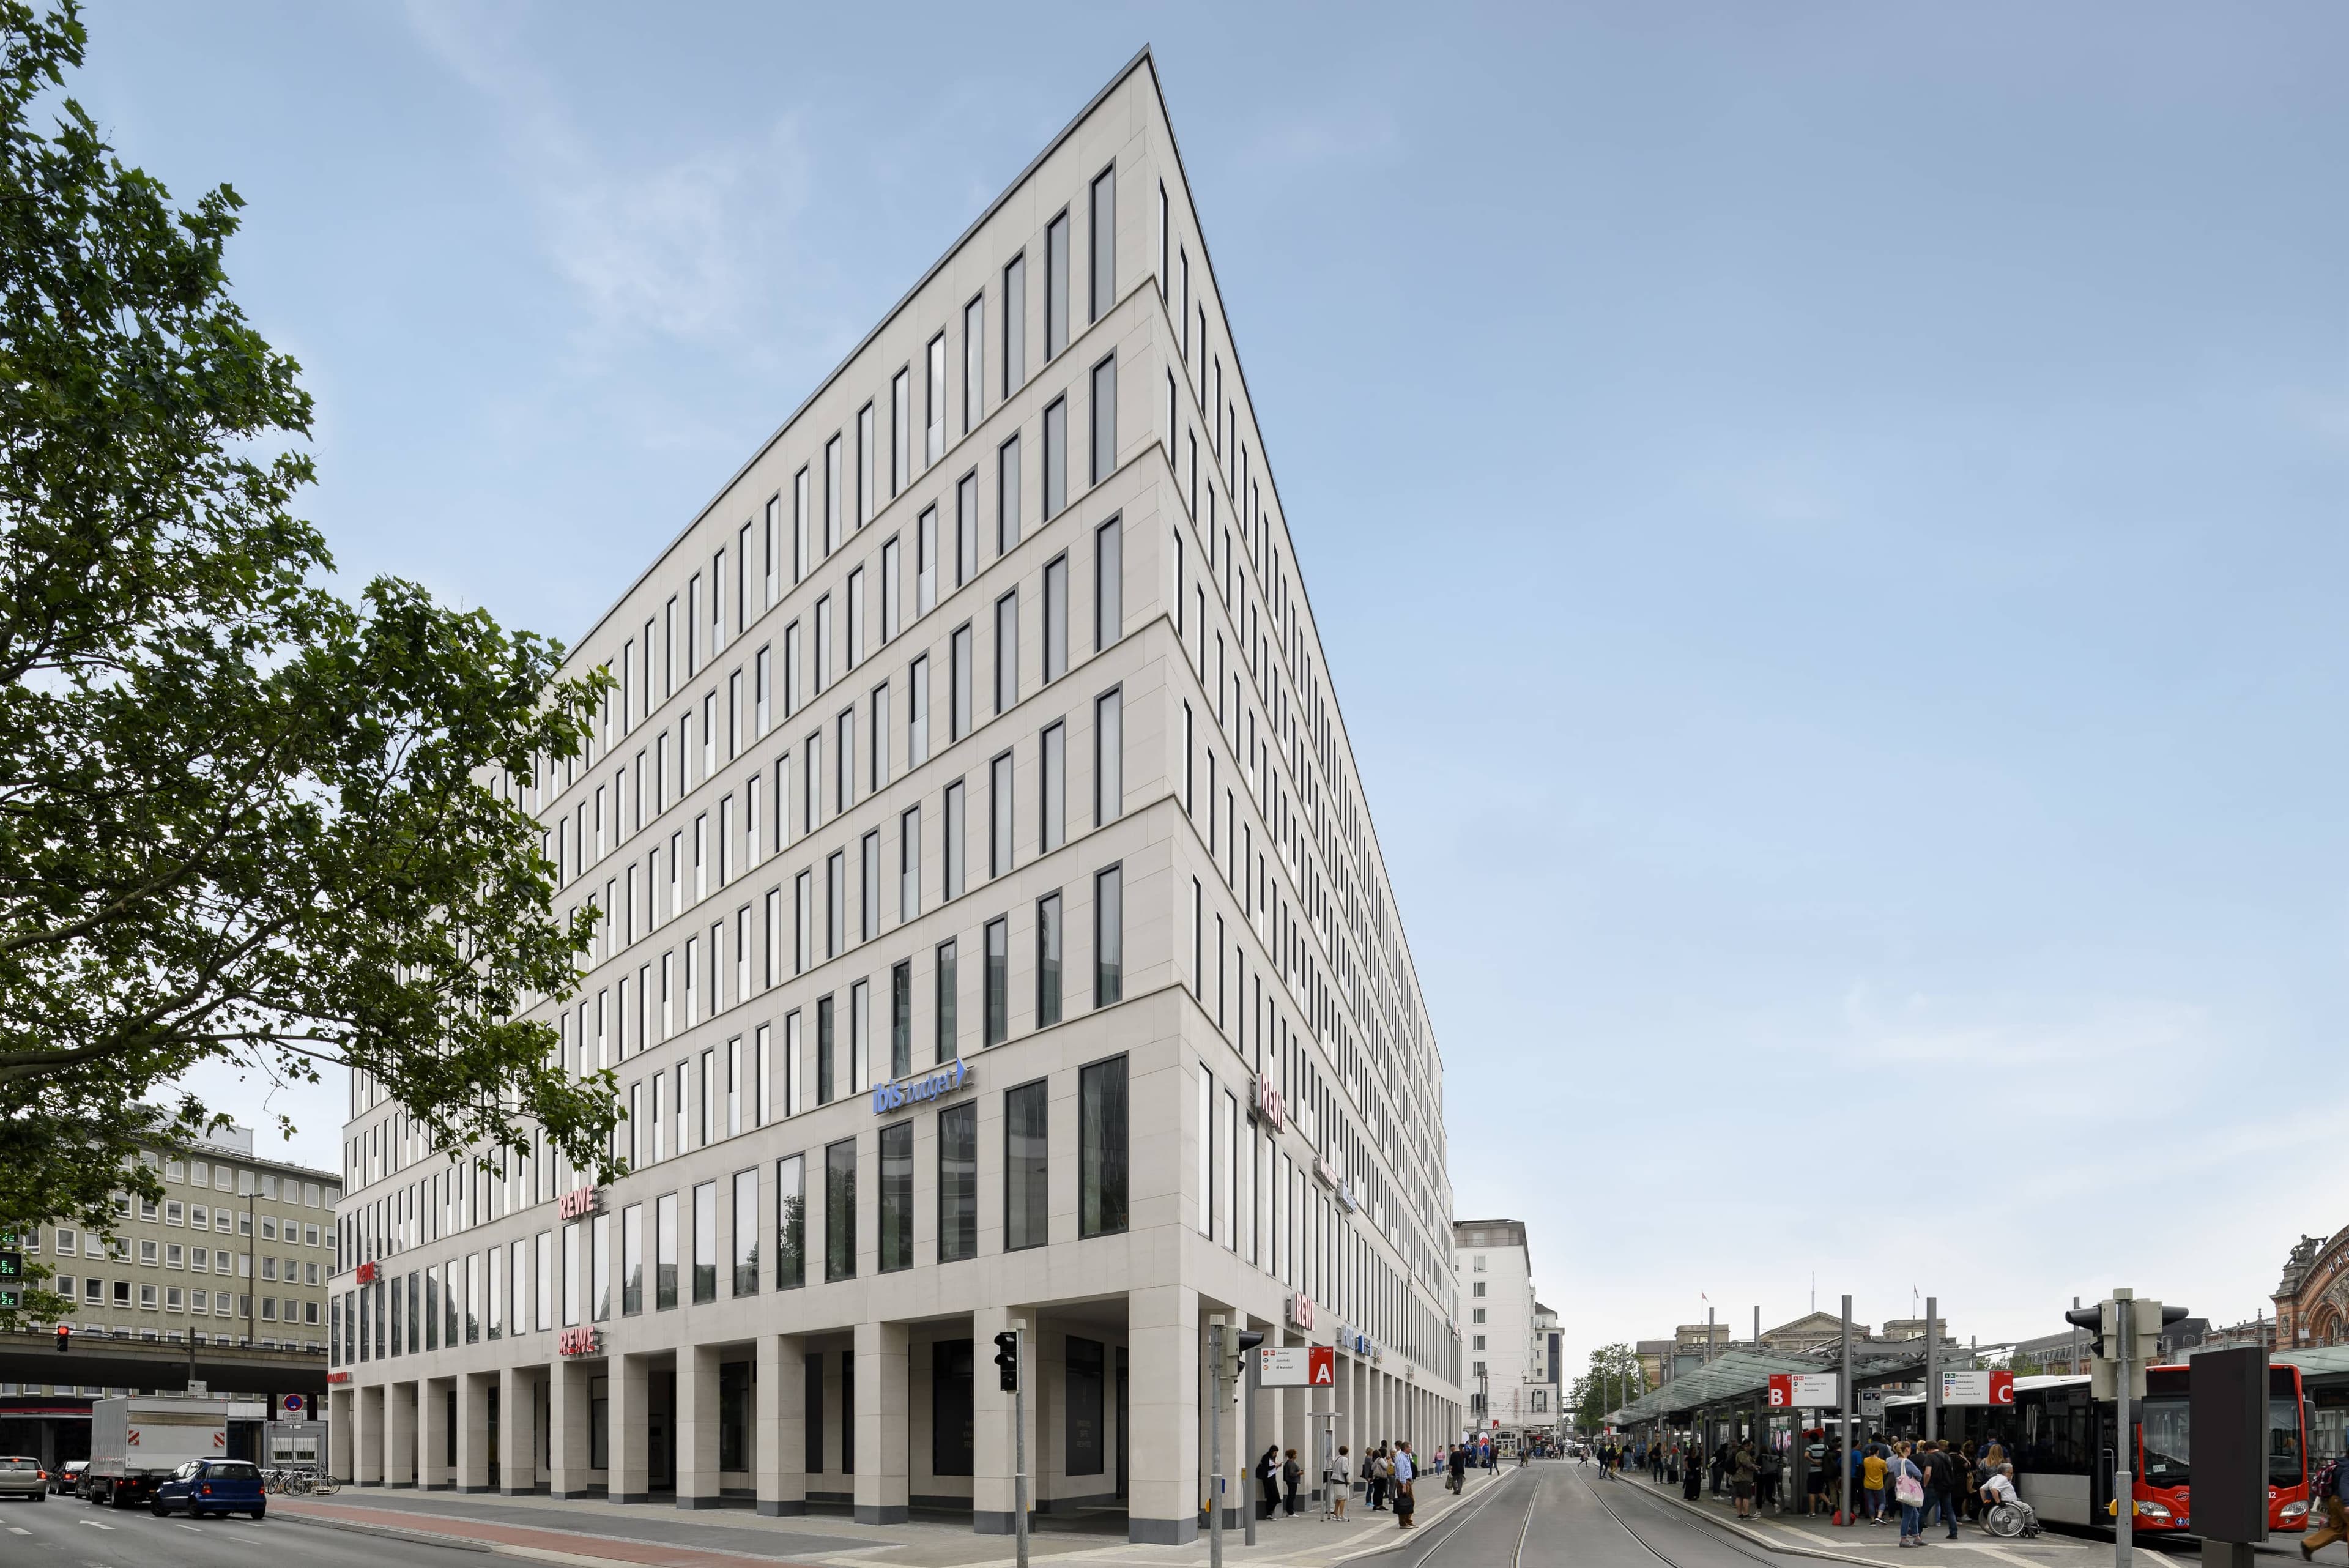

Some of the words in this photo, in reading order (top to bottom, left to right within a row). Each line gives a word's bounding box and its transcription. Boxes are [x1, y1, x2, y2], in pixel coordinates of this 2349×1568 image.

[873, 1079, 903, 1114] ibis
[907, 1069, 951, 1102] budget
[1261, 1072, 1286, 1134] REWE
[558, 1184, 594, 1220] REWE
[357, 1261, 375, 1284] REWE
[1296, 1292, 1316, 1331] REWE
[558, 1326, 595, 1356] REWE
[1316, 1363, 1332, 1383] A
[1771, 1389, 1783, 1405] B
[1998, 1384, 2012, 1403] C
